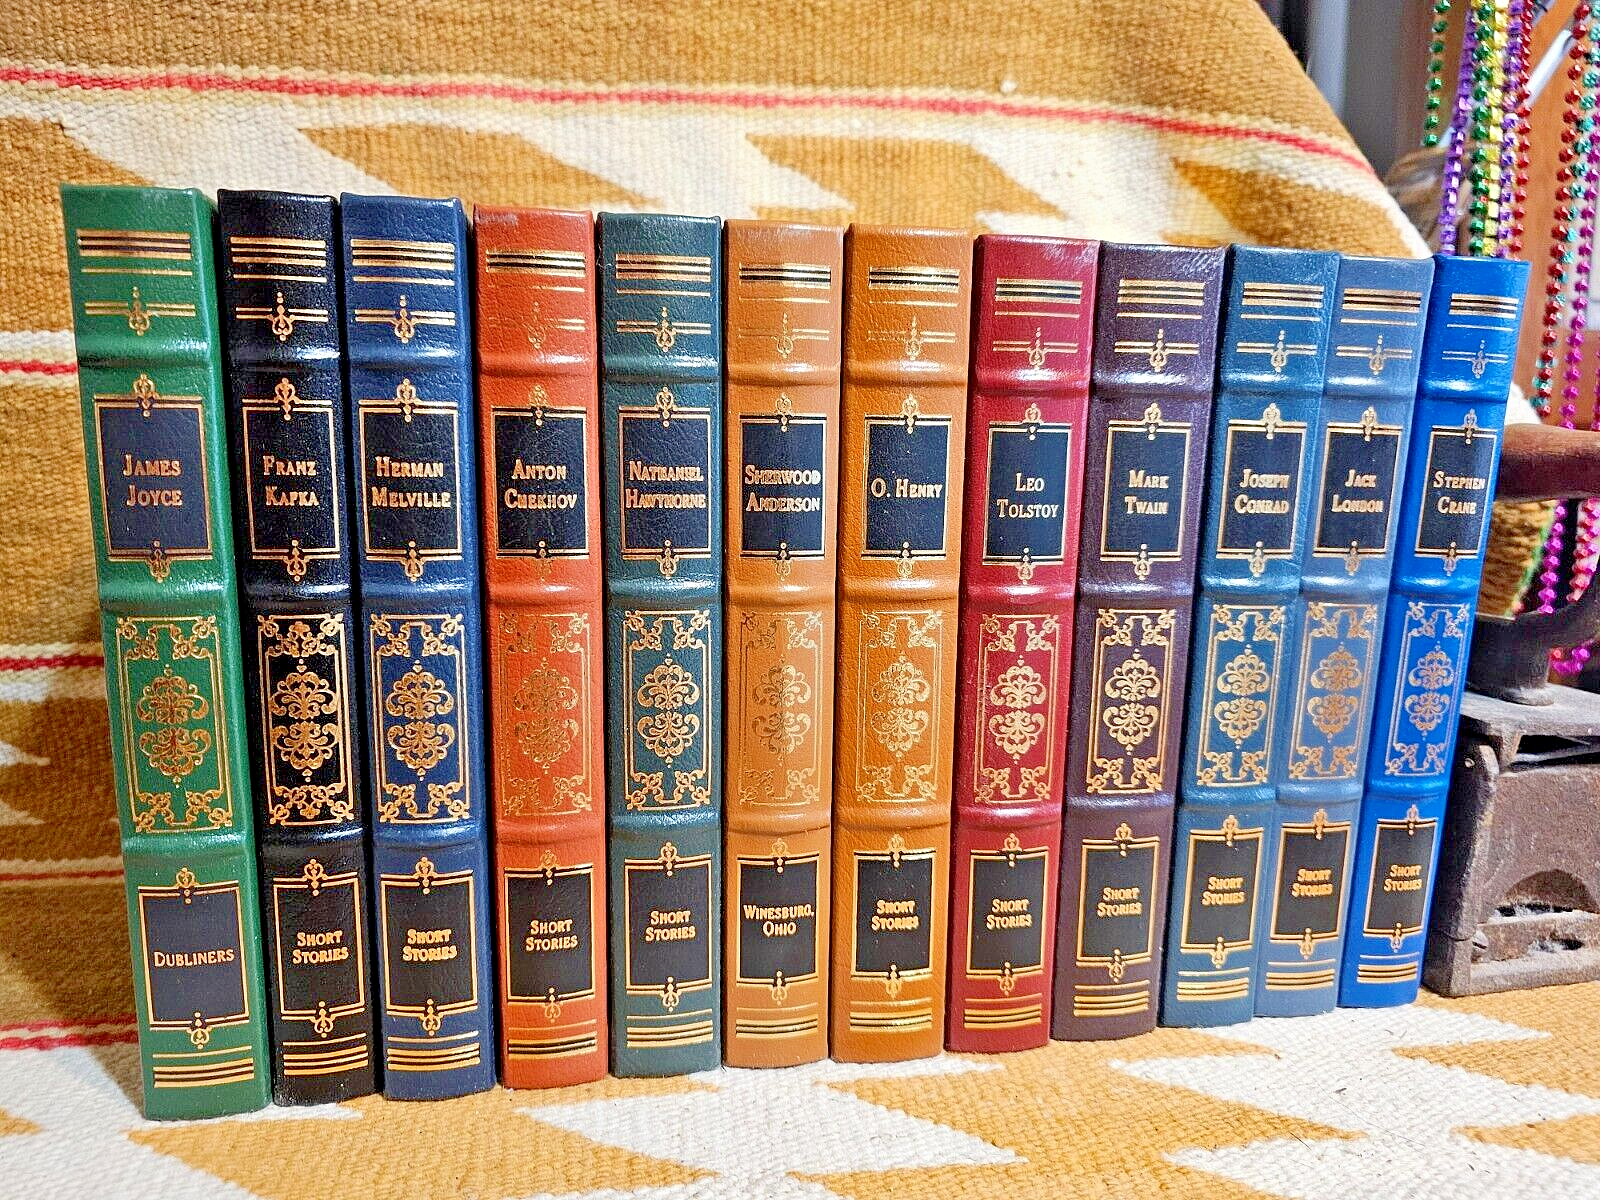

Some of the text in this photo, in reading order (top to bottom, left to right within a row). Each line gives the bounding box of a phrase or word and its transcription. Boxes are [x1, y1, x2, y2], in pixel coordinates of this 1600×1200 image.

[123, 454, 182, 477] JAMES
[263, 456, 318, 476] FRANZ
[375, 457, 444, 478] HERMAN
[512, 459, 567, 479] ANTON
[629, 461, 704, 482] NATHANIEL
[745, 465, 821, 485] SHERWOOD
[1015, 473, 1044, 492] LEO
[1128, 470, 1169, 488] MARK
[1239, 469, 1289, 488] JOSEPH
[1345, 469, 1376, 487] JACK
[1433, 471, 1485, 490] STEPHEN
[127, 485, 182, 507] JOYCE
[266, 486, 319, 507] KAFKA
[871, 478, 942, 498] O. HENRY
[372, 488, 451, 508] MELVILLE
[504, 488, 578, 509] CHEKHOV
[625, 489, 706, 508] HAWTHORNE
[746, 492, 820, 512] ANDERSON
[1124, 496, 1168, 514] TWAIN
[1234, 495, 1289, 514] CONRAD
[1332, 495, 1383, 512] LONDON
[1438, 497, 1476, 514] CRANE
[997, 499, 1059, 518] TOLSTOY
[1297, 868, 1332, 882] SHORT
[1389, 864, 1421, 878] SHORT
[1208, 877, 1244, 890] SHORT
[1292, 882, 1333, 897] STORIES
[1384, 878, 1422, 892] STORIES
[1103, 887, 1140, 901] SHORT
[1202, 891, 1245, 905] STORIES
[876, 900, 916, 915] SHORT
[992, 899, 1029, 913] SHORT
[1097, 902, 1142, 917] STORIES
[650, 910, 691, 925] SHORT
[871, 915, 919, 931] STORIES
[986, 914, 1032, 930] STORIES
[530, 919, 573, 936] SHORT
[645, 926, 696, 941] STORIES
[763, 922, 796, 936] OHIO
[297, 930, 343, 947] SHORT
[407, 929, 452, 944] SHORT
[525, 935, 578, 952] STORIES
[154, 949, 235, 967] DUBLINERS
[292, 947, 349, 964] STORIES
[402, 945, 458, 962] STORIES
